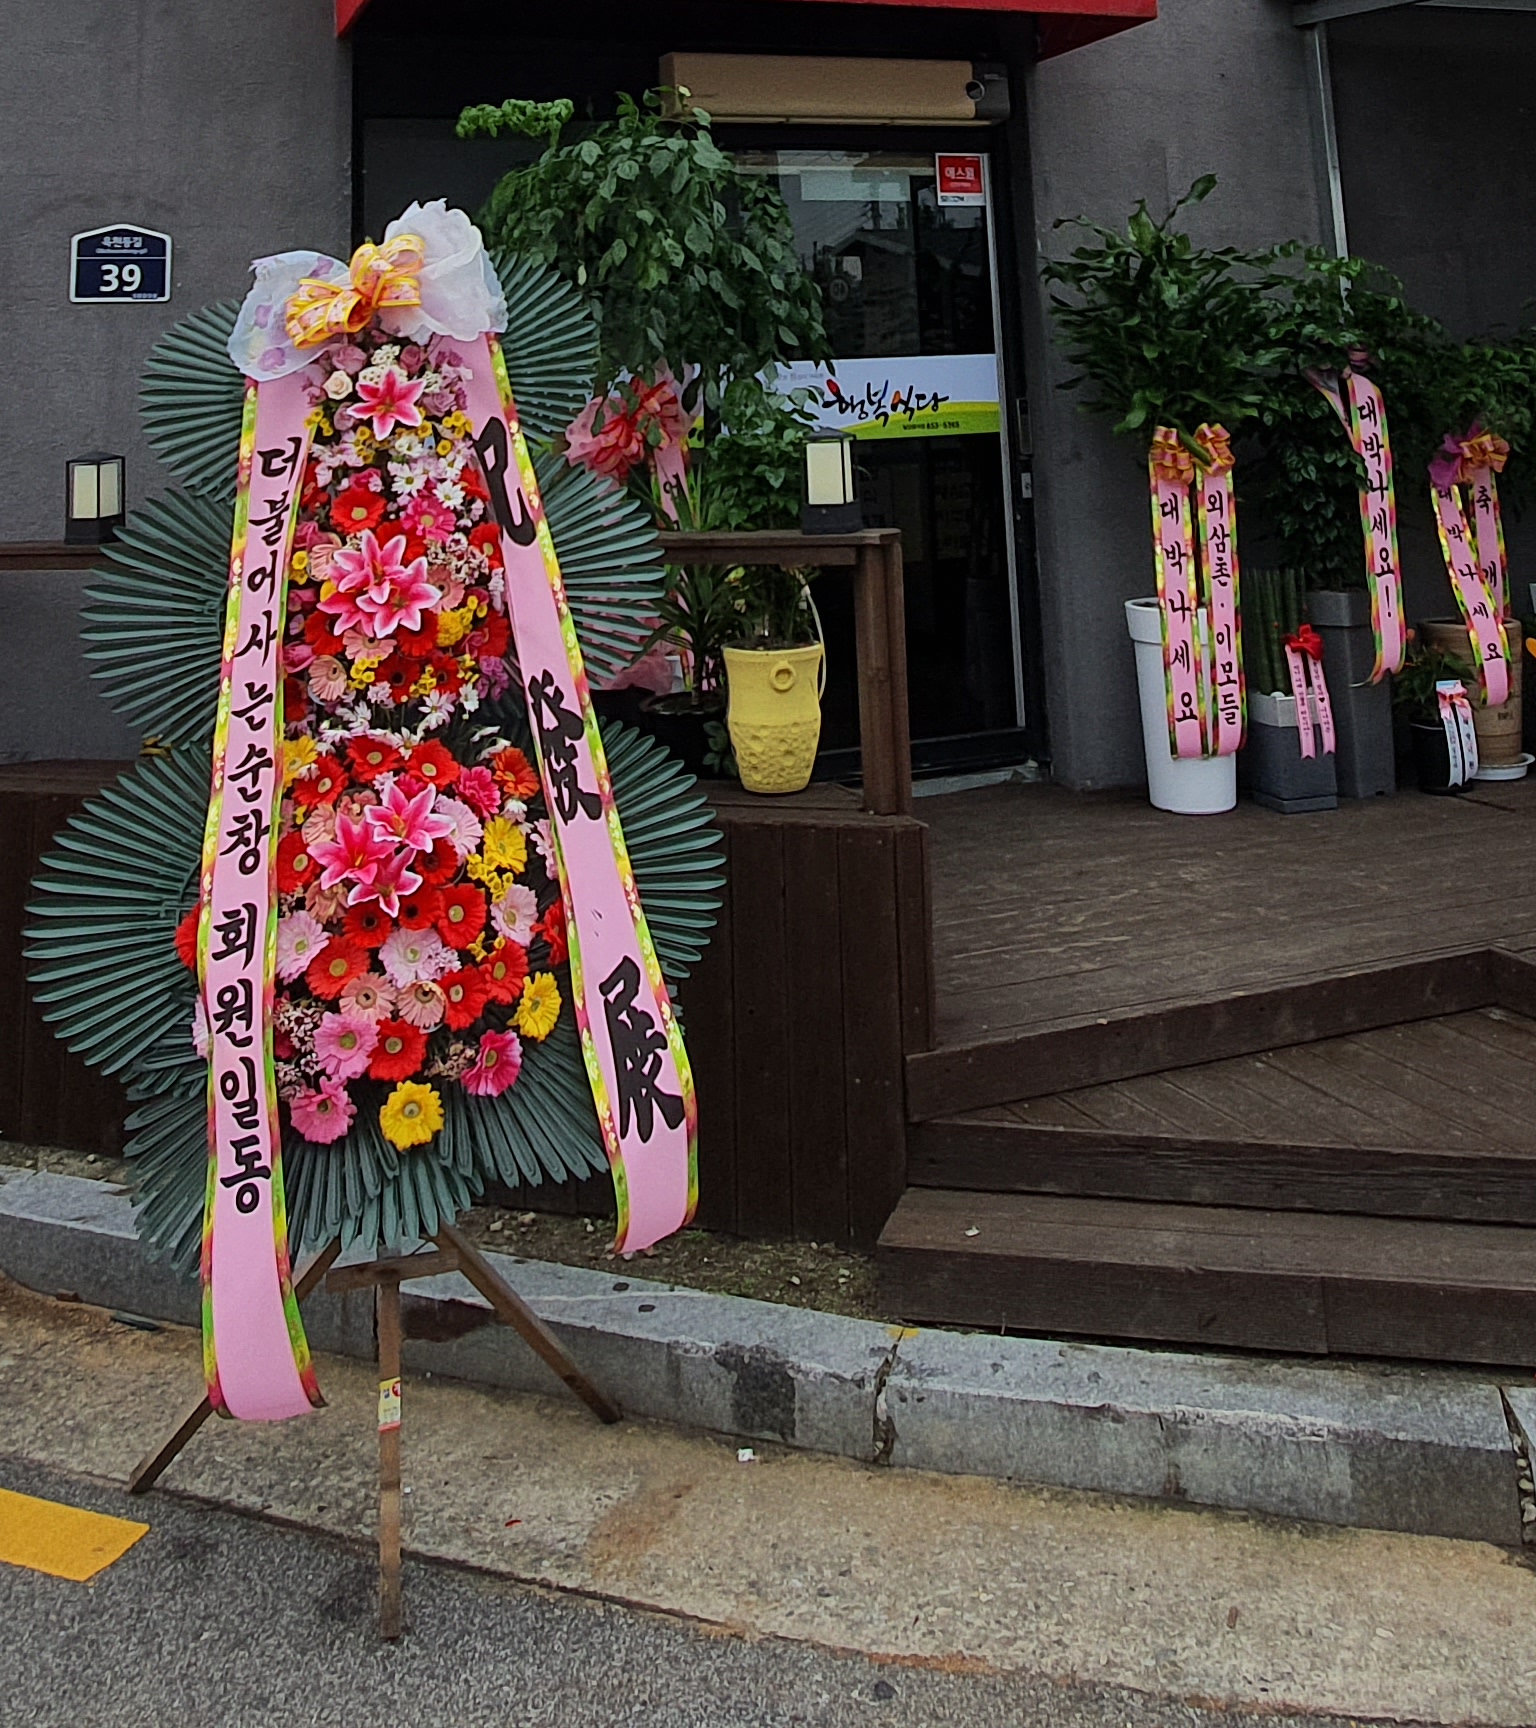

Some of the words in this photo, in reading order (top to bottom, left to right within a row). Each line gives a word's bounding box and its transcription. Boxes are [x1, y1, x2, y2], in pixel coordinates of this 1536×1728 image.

[99, 264, 142, 292] 39
[821, 377, 950, 427] 행복식당
[1357, 396, 1395, 619] 대박나세요!
[1439, 489, 1504, 661] 대박나세요
[1160, 493, 1198, 723] 대박나세요
